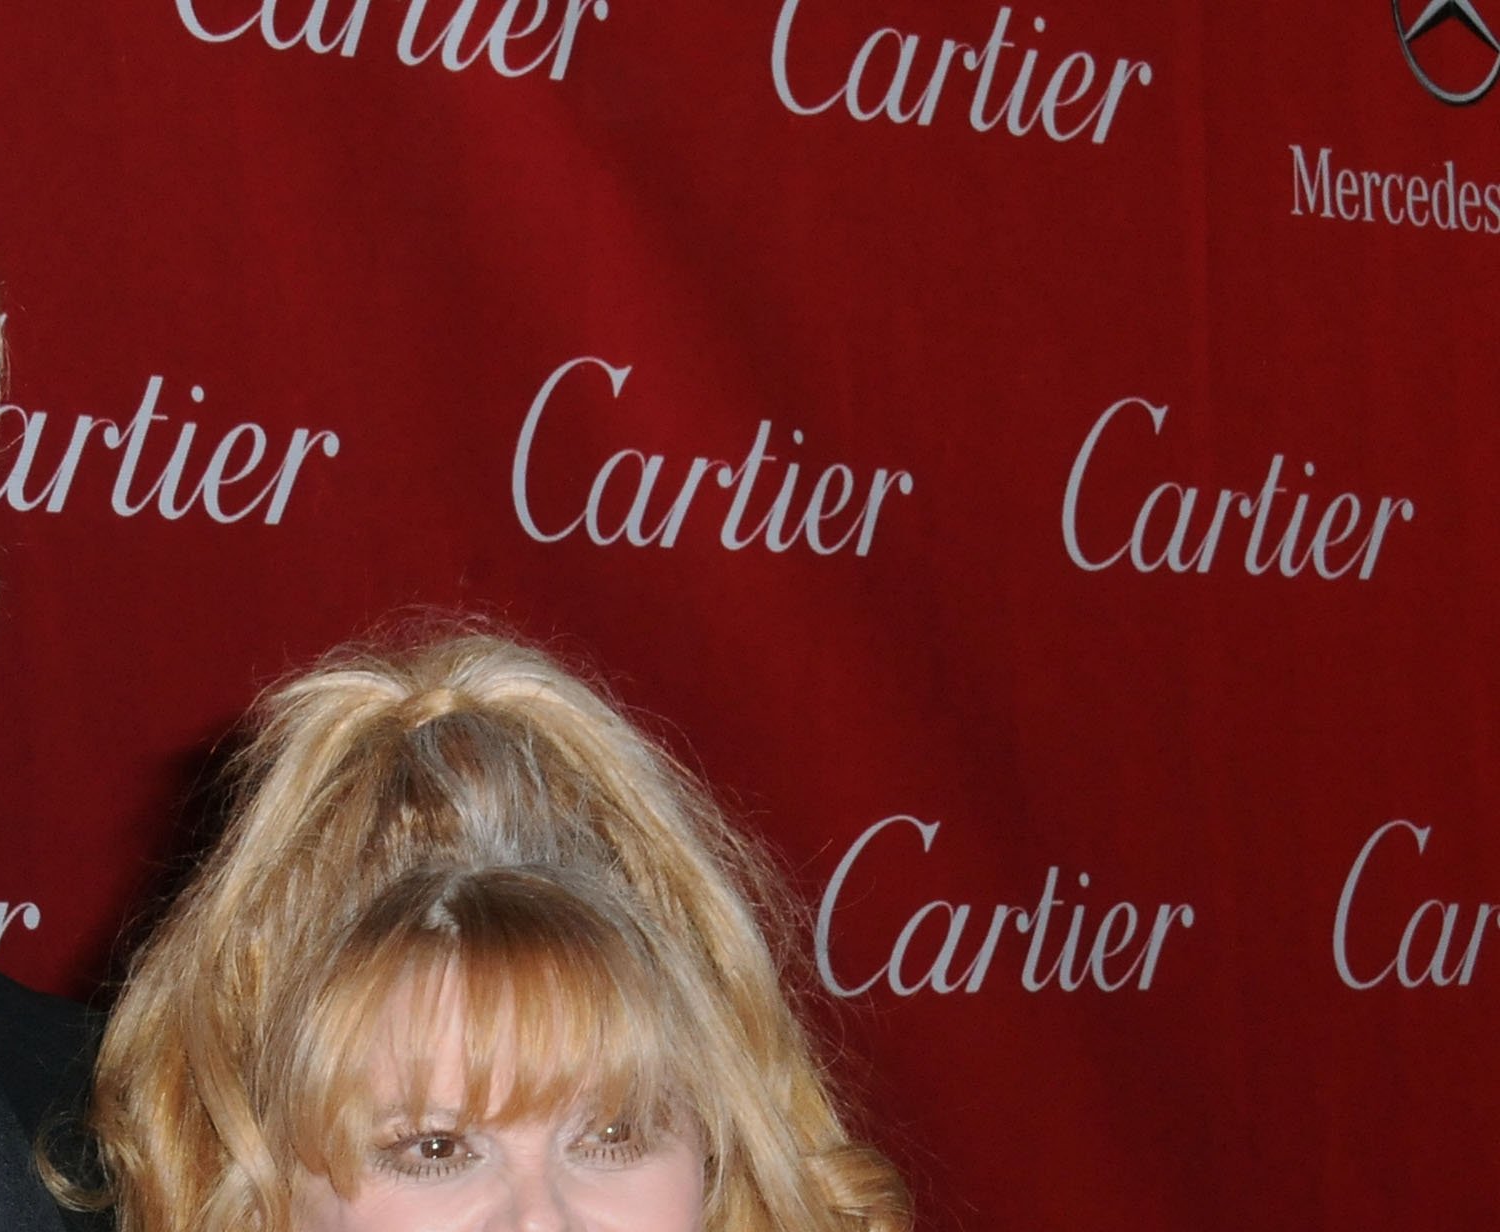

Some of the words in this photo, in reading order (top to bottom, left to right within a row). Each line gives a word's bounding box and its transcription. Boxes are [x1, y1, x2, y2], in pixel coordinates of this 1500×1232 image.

[175, 0, 608, 81] arier
[771, 0, 1153, 144] Cartier
[1289, 144, 1500, 234] Mercedes
[511, 356, 914, 557] Cartier
[1061, 397, 1414, 580] Cartier
[814, 814, 1195, 998] Cartier
